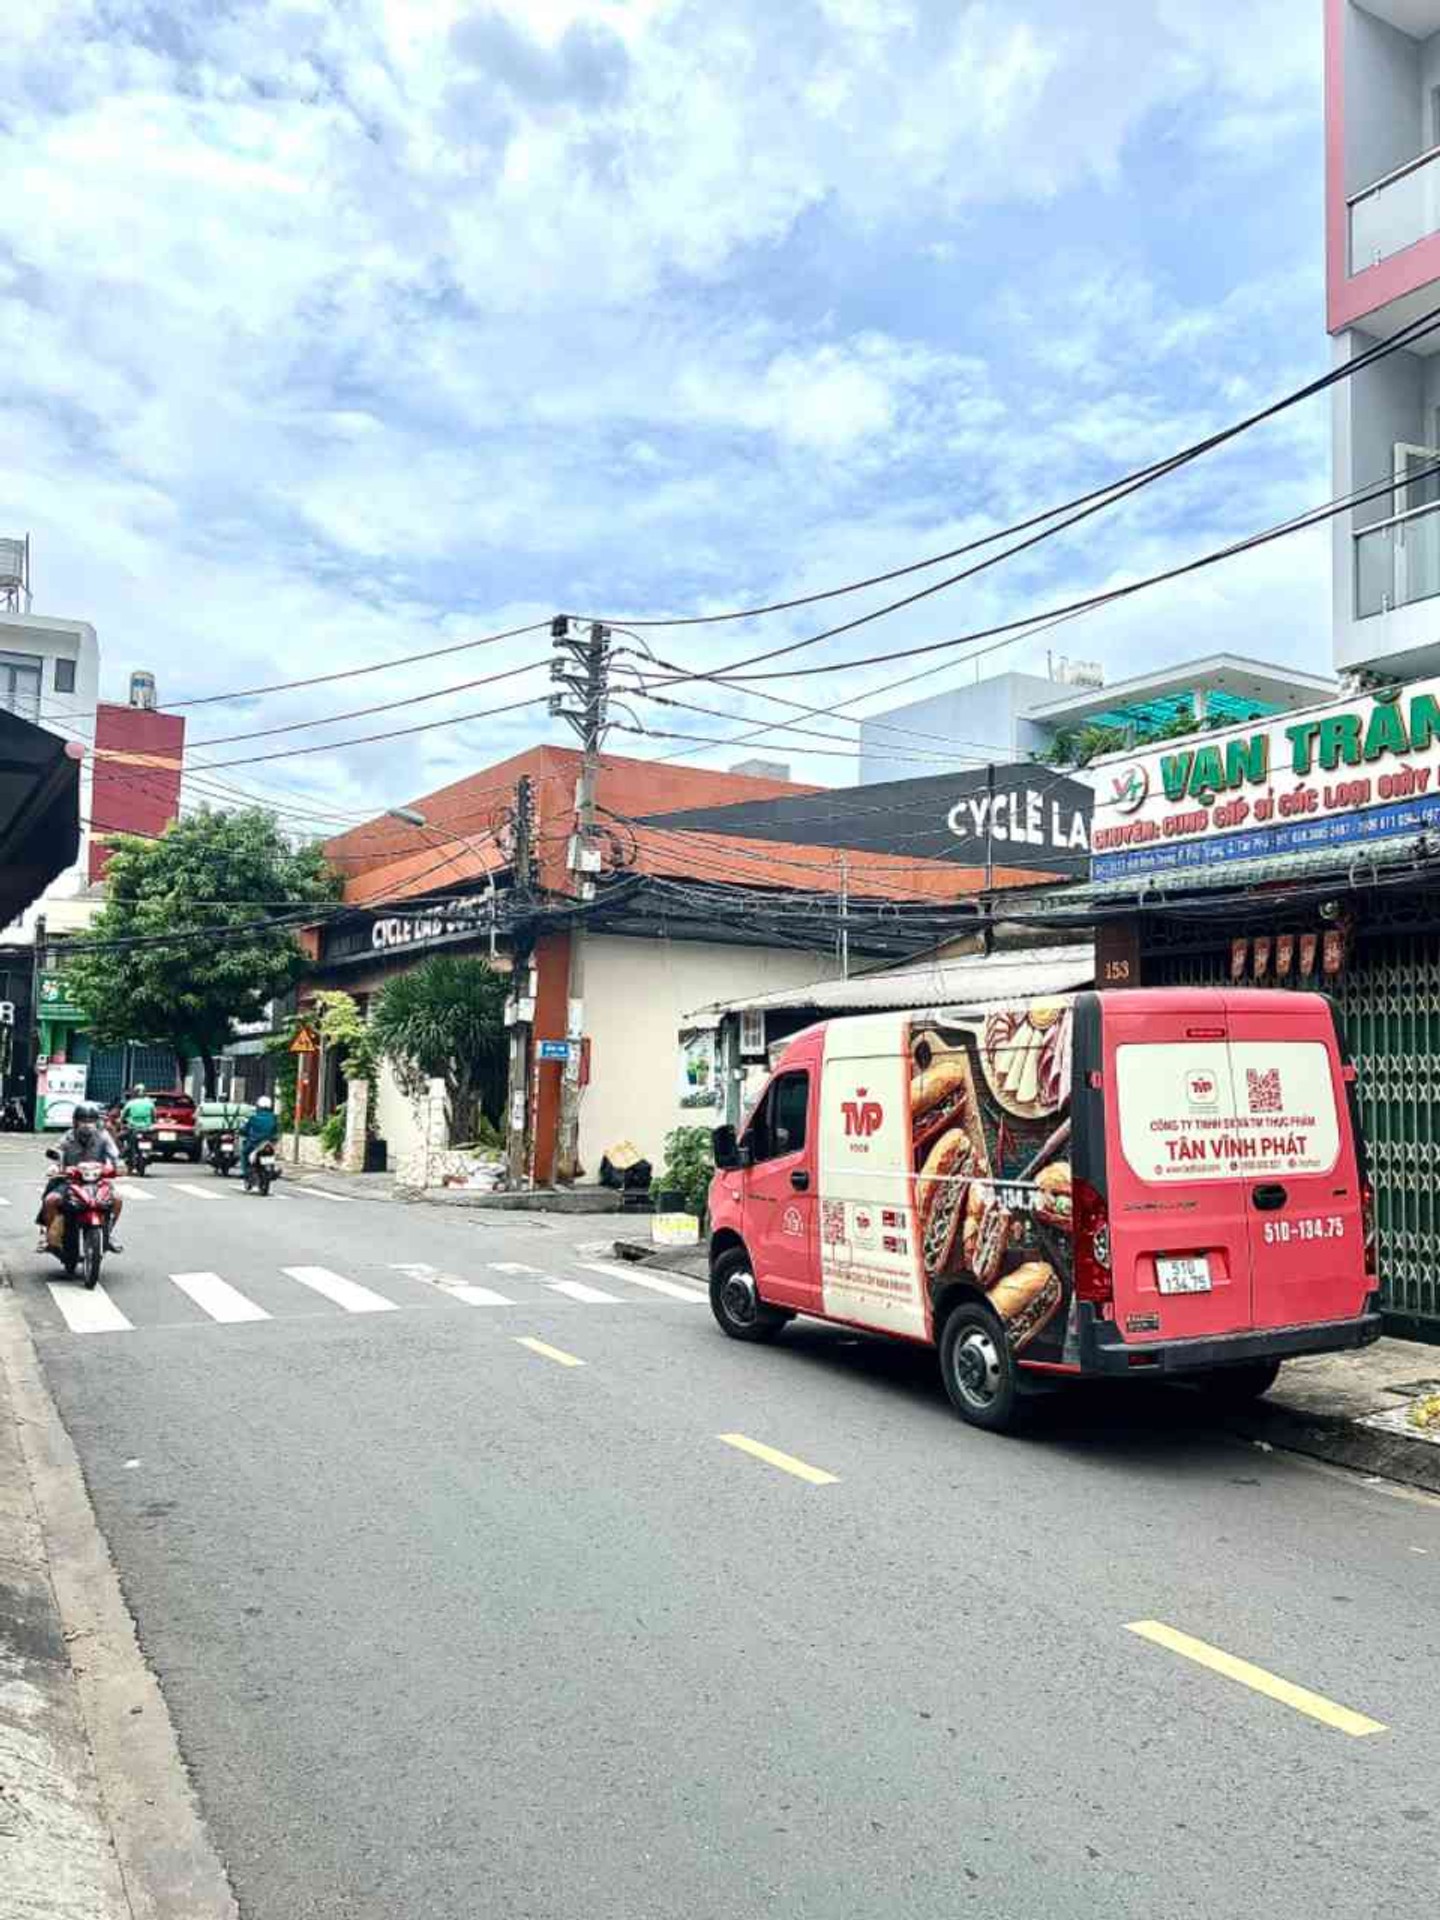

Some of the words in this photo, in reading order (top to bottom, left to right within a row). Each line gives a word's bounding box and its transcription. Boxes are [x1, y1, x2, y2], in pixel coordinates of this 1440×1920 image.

[1160, 732, 1269, 806] VẠN
[947, 790, 1044, 845] CYCLE
[1052, 800, 1089, 851] LA
[1163, 809, 1209, 837] CUNG
[1213, 796, 1250, 829] CẤP
[1278, 782, 1319, 816] CÁC
[1323, 777, 1371, 809] LOẠI
[372, 918, 411, 949] CYCLE
[1104, 959, 1129, 980] 153
[841, 1101, 883, 1137] TVP
[1165, 1135, 1206, 1161] TÂN
[1210, 1134, 1257, 1159] VĨNH
[1261, 1132, 1307, 1156] PHÁT
[1264, 1216, 1345, 1243] 51D-134.75
